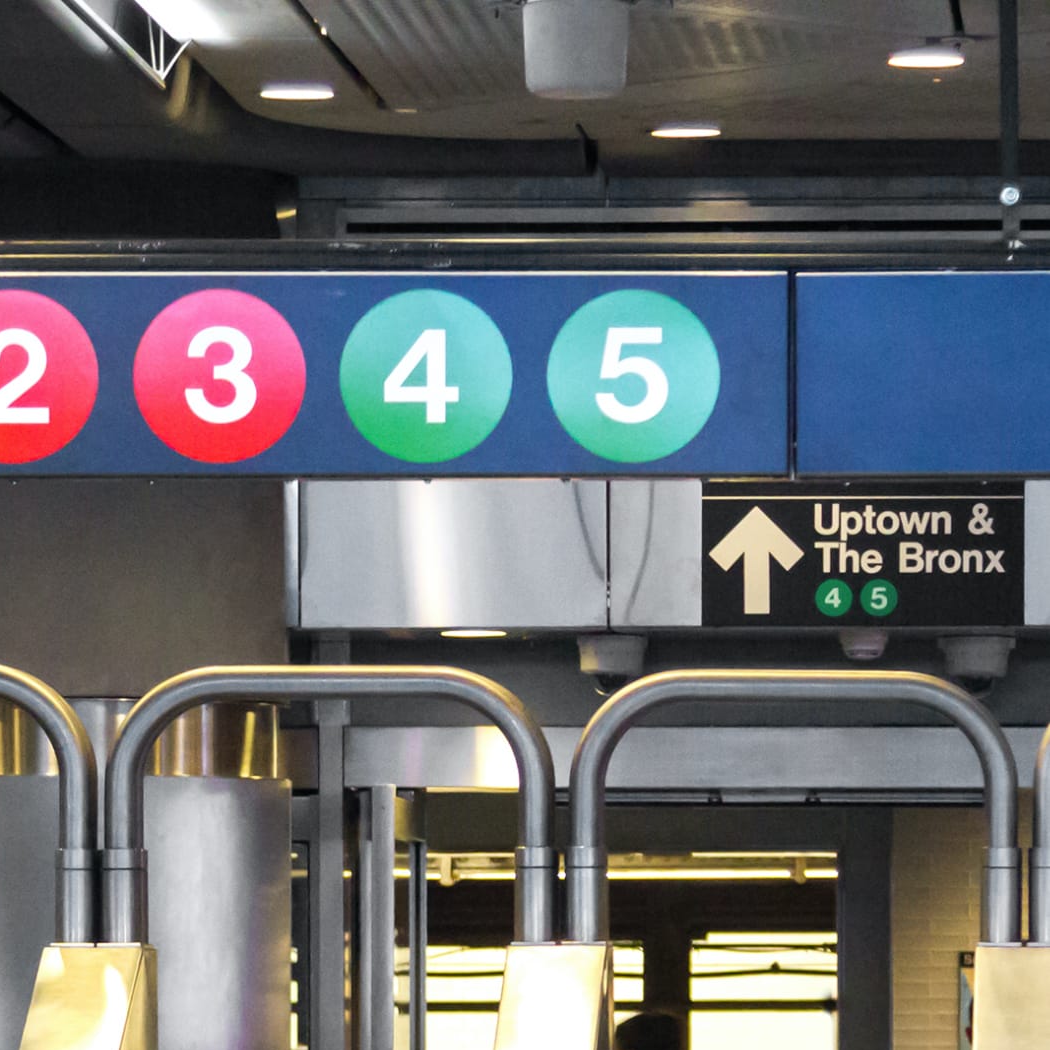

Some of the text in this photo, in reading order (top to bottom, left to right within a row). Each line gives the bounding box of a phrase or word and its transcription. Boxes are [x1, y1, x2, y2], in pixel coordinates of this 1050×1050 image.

[184, 325, 258, 424] 3
[383, 328, 459, 424] 4
[595, 326, 669, 424] 5
[814, 502, 995, 541] Uptown &
[814, 541, 1006, 574] The Bronx
[824, 587, 888, 610] 4 5
